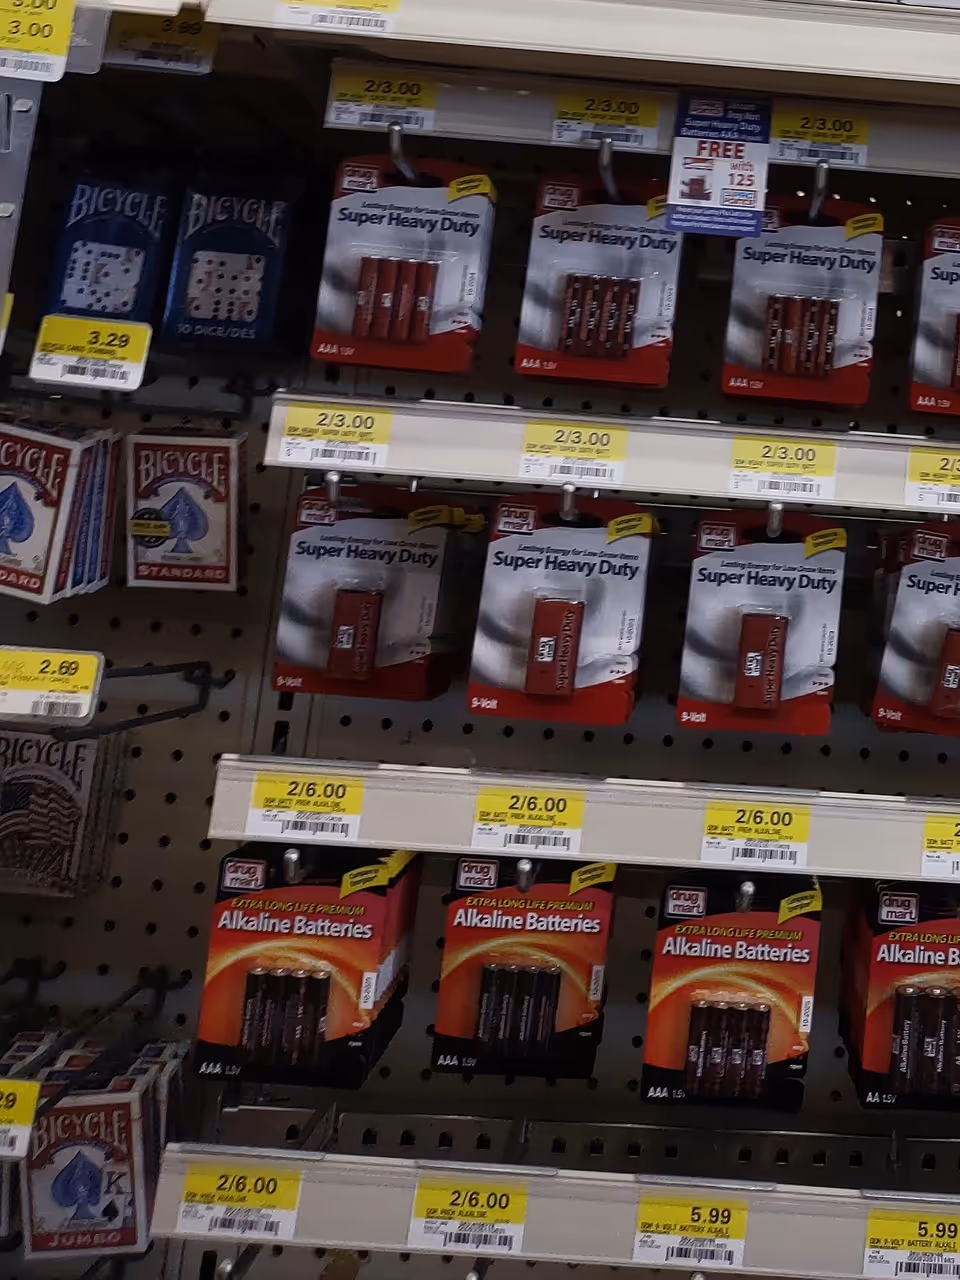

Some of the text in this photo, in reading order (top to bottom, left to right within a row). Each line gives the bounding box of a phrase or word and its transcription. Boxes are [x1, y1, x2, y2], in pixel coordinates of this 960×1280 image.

[364, 79, 421, 96] 2/3.00
[585, 97, 639, 114] 2/3.00
[800, 116, 853, 133] 2/3.00
[696, 140, 746, 159] FREE
[728, 173, 755, 186] 125
[65, 184, 168, 238] BICYCLE
[184, 193, 287, 247] BICYCLE
[337, 207, 478, 237] Super Heavy Duty
[540, 224, 677, 253] Super Heavy Duty
[743, 246, 876, 274] Super Heavy Duty
[87, 331, 129, 348] 3.29
[317, 412, 375, 429] 2/3.00
[553, 429, 611, 447] 2/3.00
[761, 445, 816, 462] 2/3.00
[138, 450, 225, 496] BICYCLE
[295, 541, 438, 569] Super Heavy Duty
[137, 565, 226, 579] STANDARD
[493, 551, 639, 580] Super Heavy Duty
[697, 568, 836, 594] Super Heavy Duty
[906, 575, 951, 596] Super
[471, 698, 498, 710] 9-Volt
[287, 781, 346, 798] 2/6.00
[508, 795, 567, 812] 2/6.00
[736, 809, 792, 826] 2/6.00
[217, 911, 372, 939] Alkaline Batteries
[453, 909, 601, 933] Alkaline Batteries
[662, 937, 809, 963] Alkaline Batteries
[876, 944, 946, 966] Alkaline
[647, 1087, 668, 1098] AAA
[32, 1110, 128, 1160] BICYCLE
[105, 1171, 127, 1194] K
[216, 1175, 277, 1193] 2/6.00
[450, 1191, 510, 1209] 2/6.00
[691, 1208, 731, 1224] 5.99
[918, 1222, 958, 1238] 5.99
[49, 1232, 120, 1247] JUMBO
